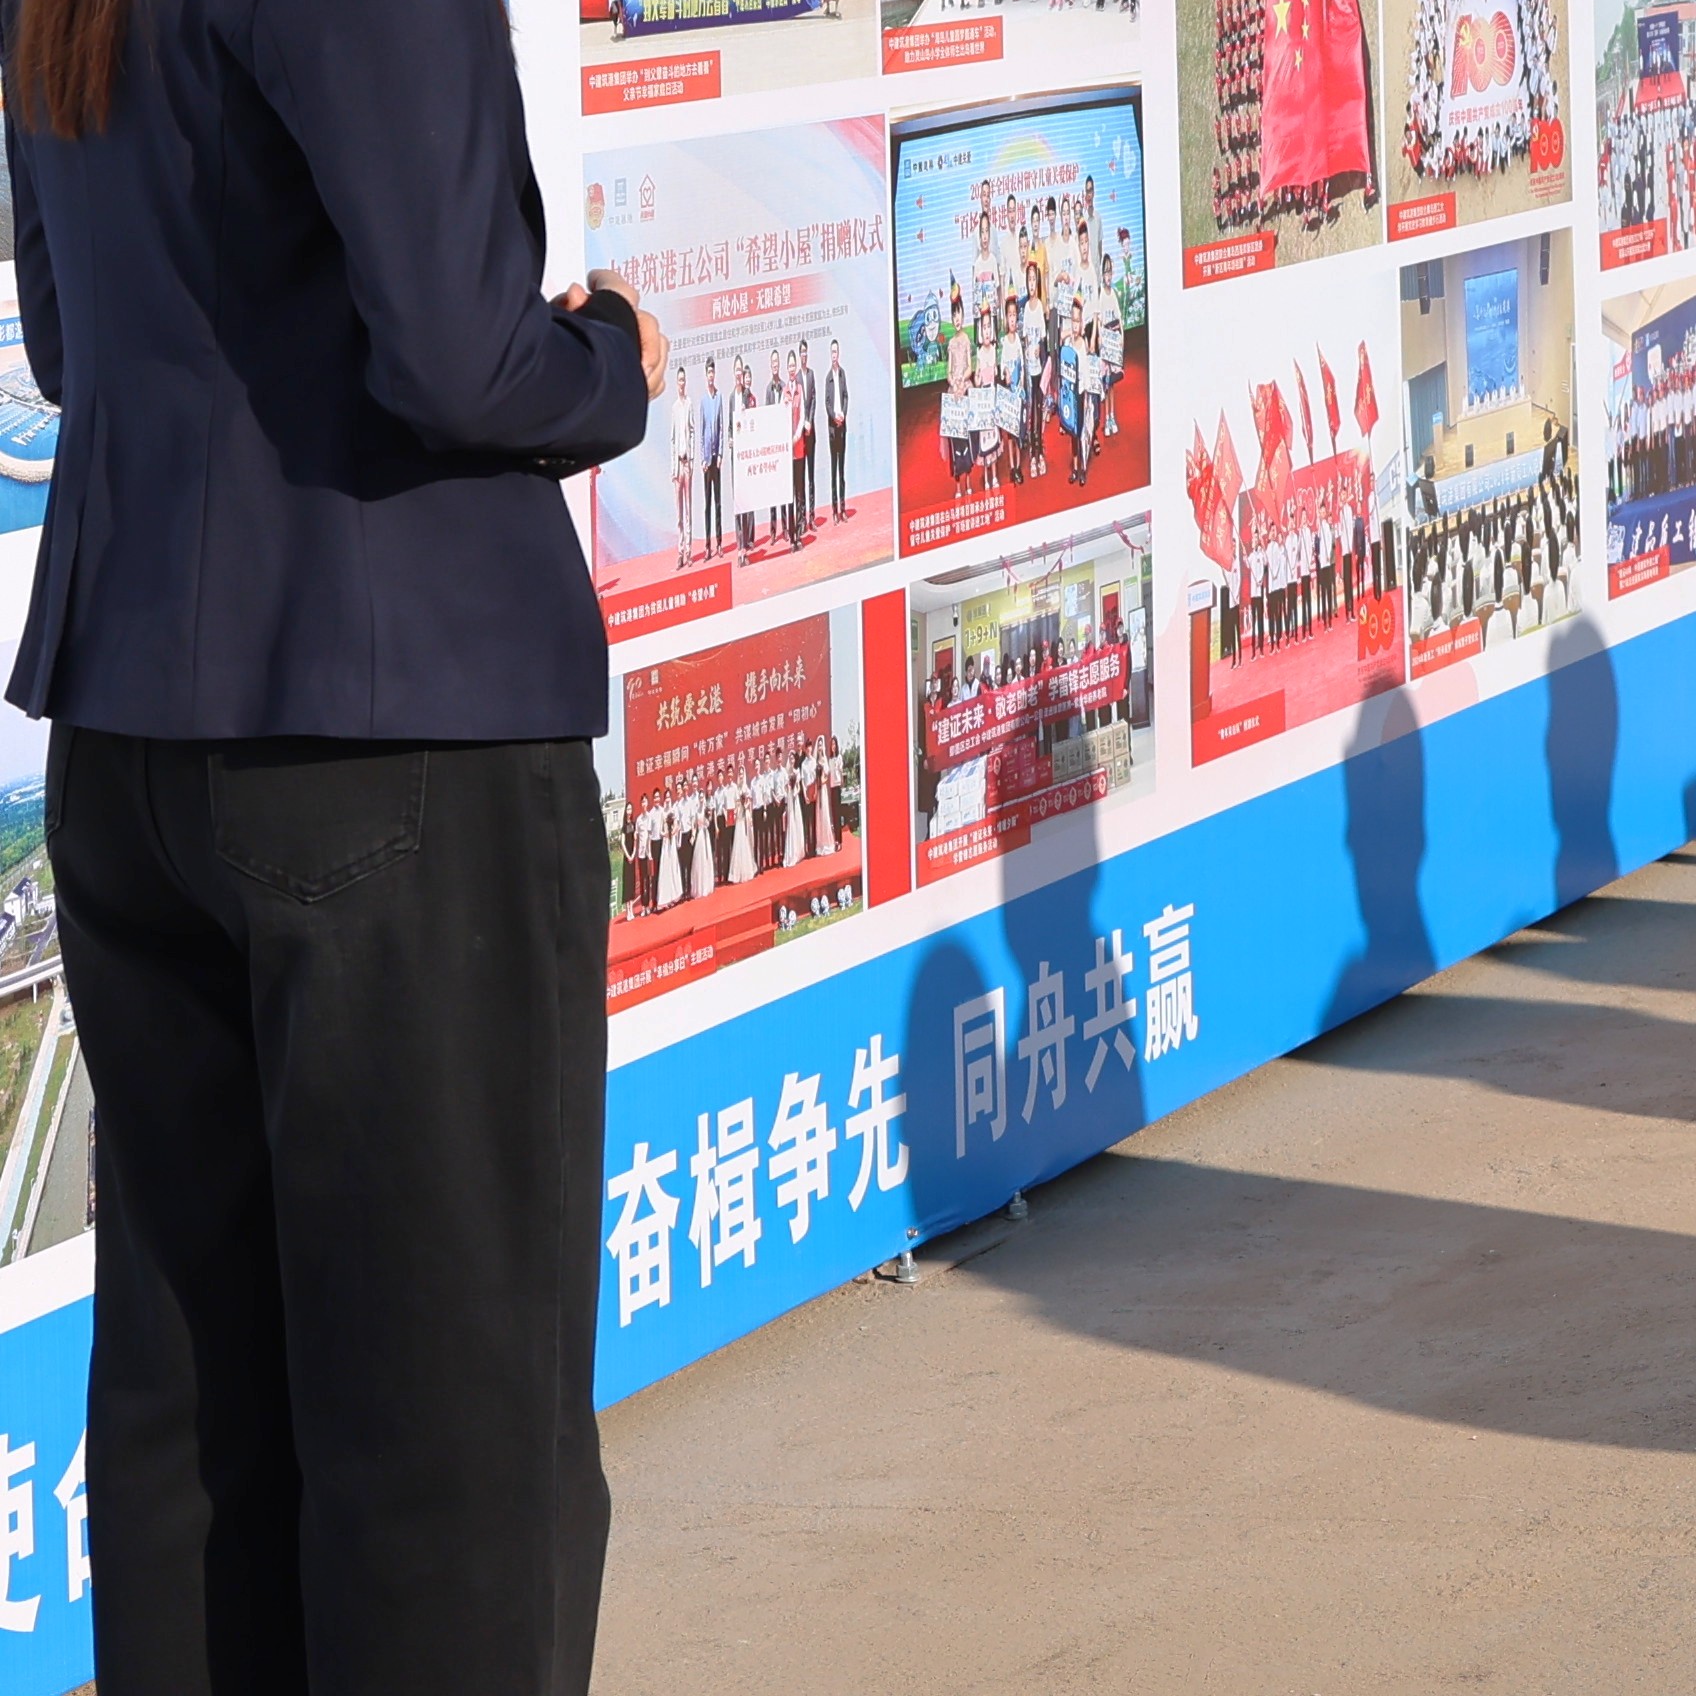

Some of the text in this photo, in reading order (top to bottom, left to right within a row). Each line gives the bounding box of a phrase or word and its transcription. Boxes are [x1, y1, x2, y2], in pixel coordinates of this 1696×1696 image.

[605, 902, 1199, 1328] 奋楫争先 同舟共赢
